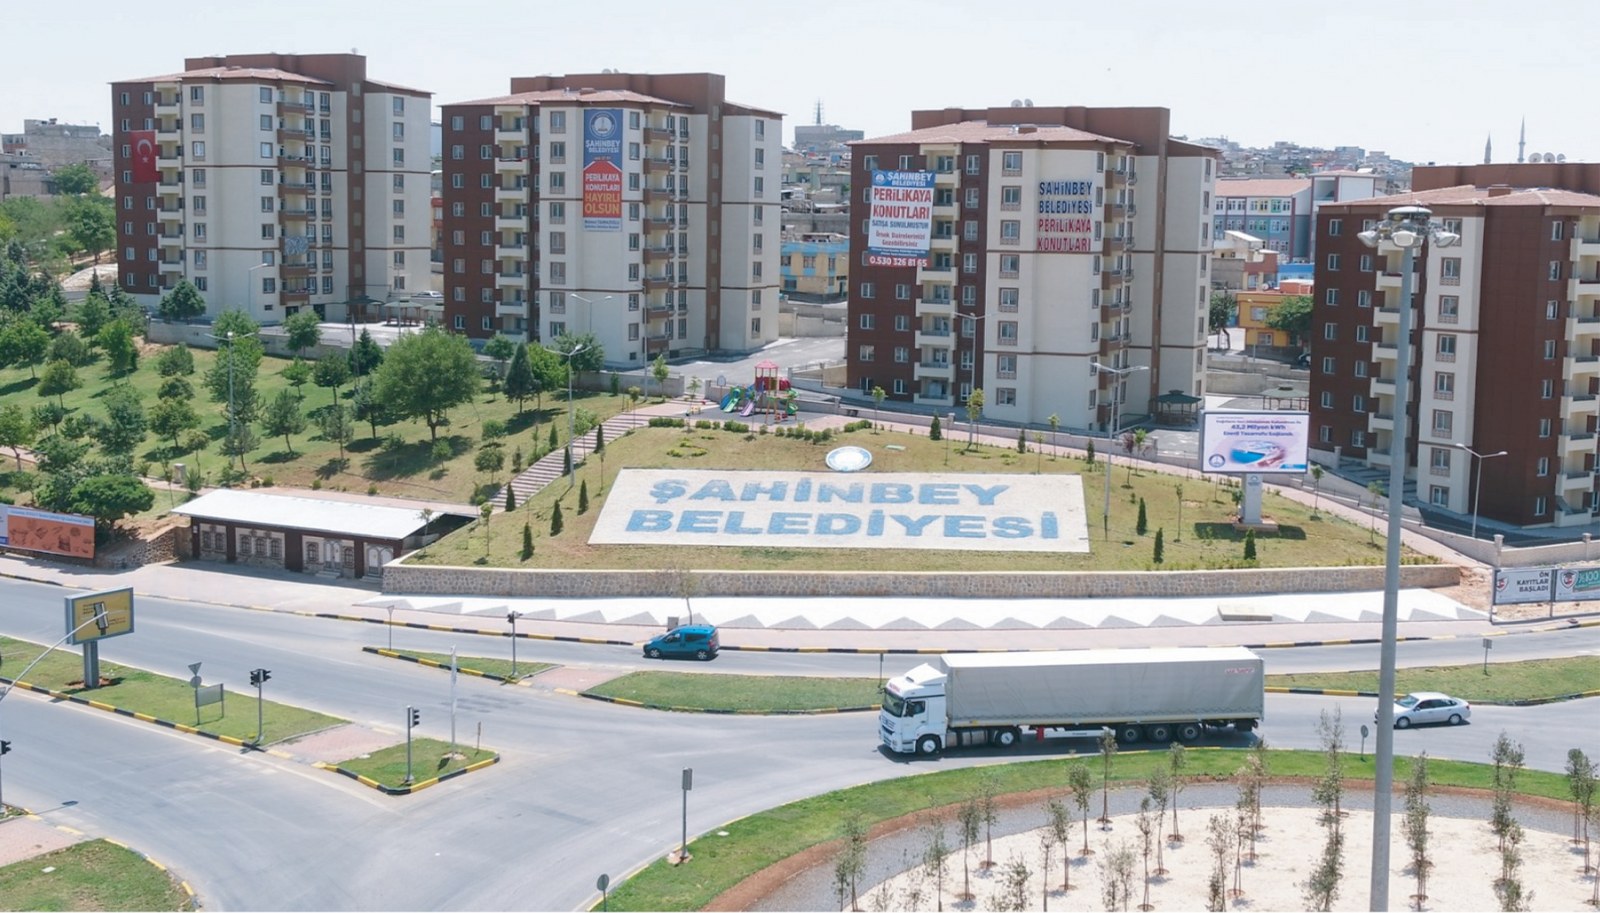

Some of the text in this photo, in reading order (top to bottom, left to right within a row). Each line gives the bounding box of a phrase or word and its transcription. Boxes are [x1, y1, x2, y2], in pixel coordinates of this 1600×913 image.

[585, 192, 620, 203] HAYIRLI
[584, 203, 620, 214] OLSUN
[873, 204, 930, 219] KONUTLARI
[1037, 237, 1091, 251] KONUTLARI
[650, 477, 1010, 506] ŞAHİNBEY
[626, 509, 1059, 539] BELEDİYESİ
